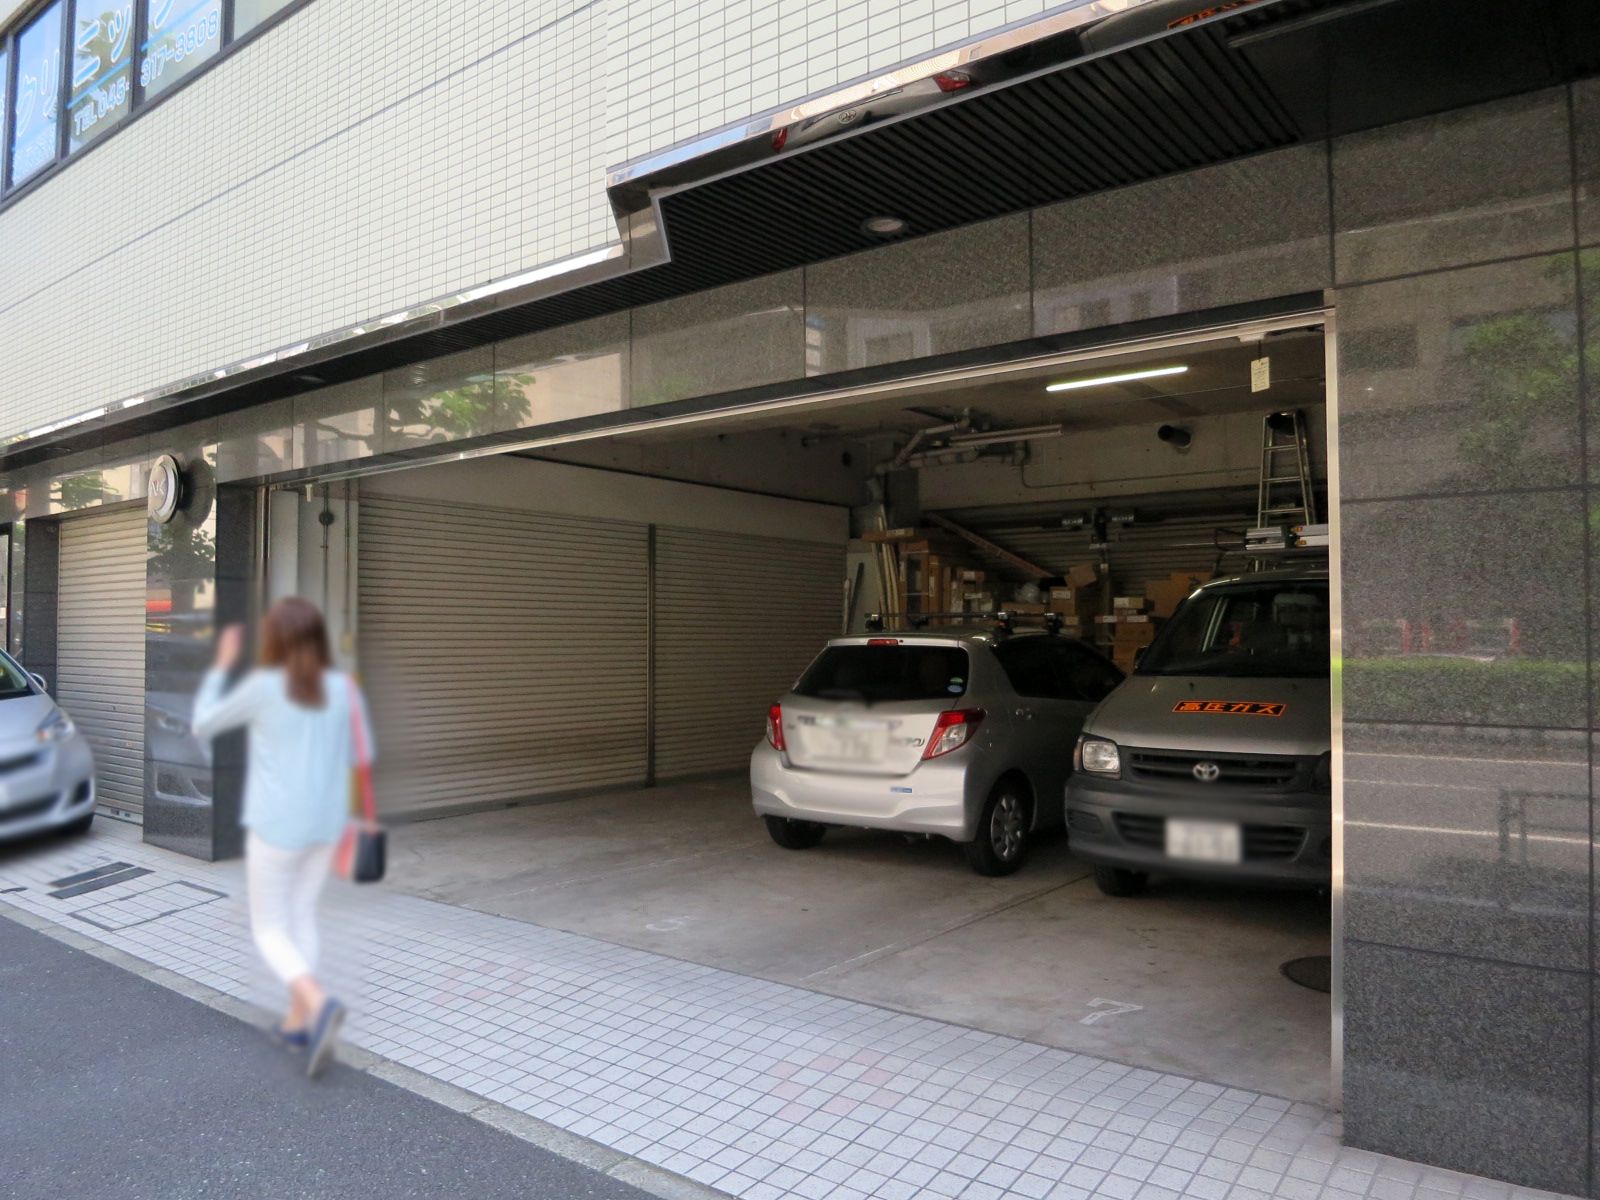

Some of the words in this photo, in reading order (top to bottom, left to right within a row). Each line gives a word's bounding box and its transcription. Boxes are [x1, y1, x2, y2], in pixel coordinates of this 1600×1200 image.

[74, 101, 97, 136] TEL
[1178, 701, 1278, 715] 高圧ガス
[1079, 997, 1144, 1026] 7
